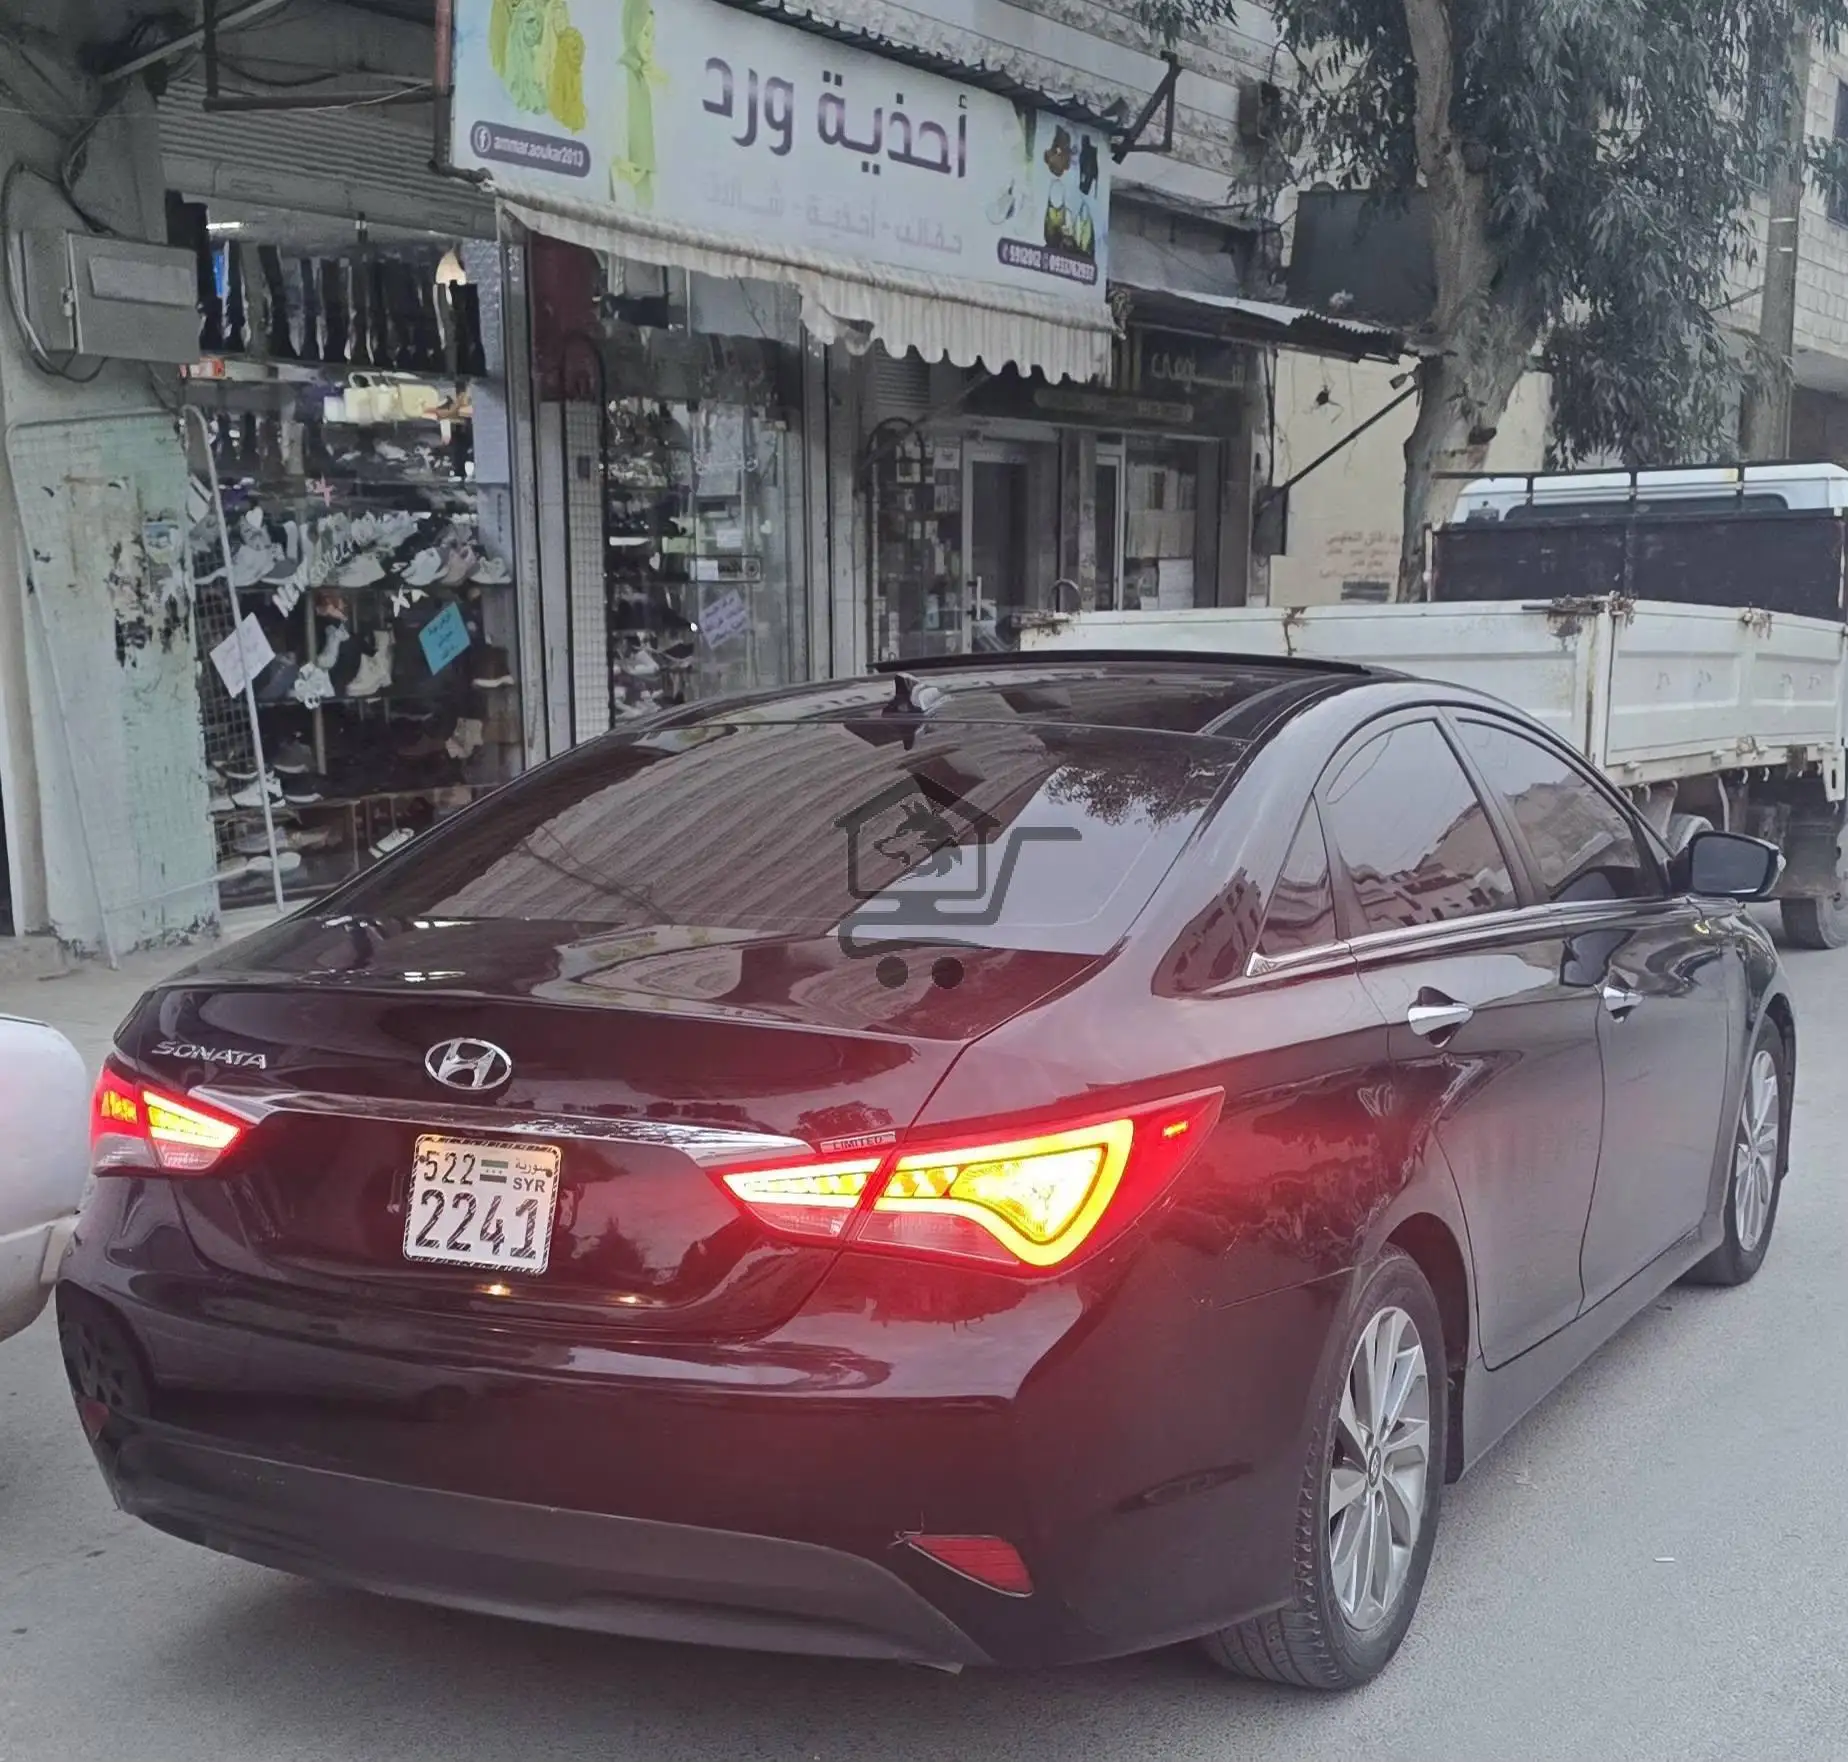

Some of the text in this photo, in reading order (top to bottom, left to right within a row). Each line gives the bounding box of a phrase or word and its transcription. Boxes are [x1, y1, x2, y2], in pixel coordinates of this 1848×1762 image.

[702, 56, 967, 178] أحذية ورد
[151, 1041, 267, 1069] SONATA
[832, 1135, 883, 1150] LIMITED
[423, 1150, 476, 1186] 522
[512, 1177, 546, 1193] SYR
[415, 1189, 539, 1260] 2241
